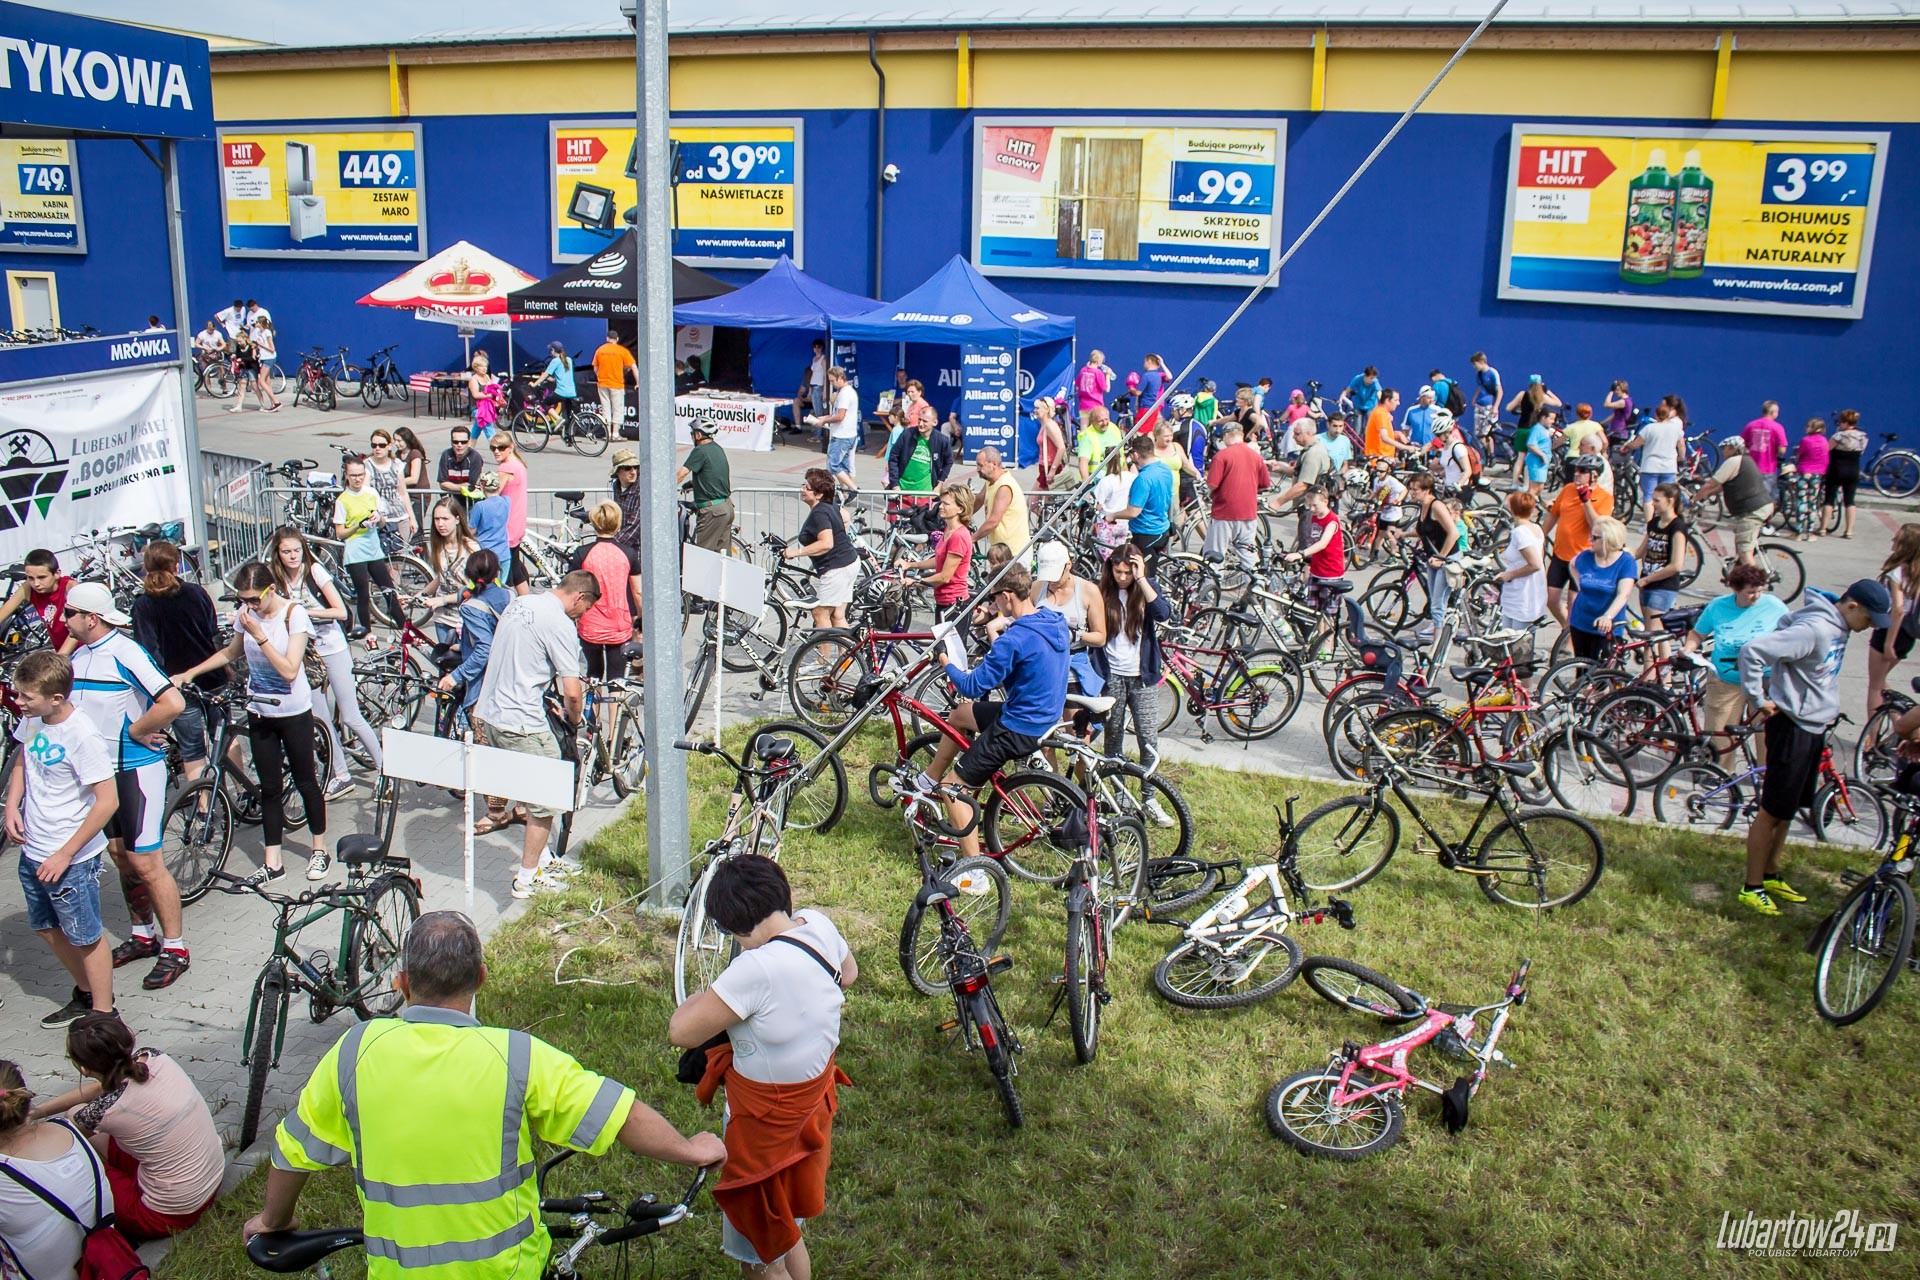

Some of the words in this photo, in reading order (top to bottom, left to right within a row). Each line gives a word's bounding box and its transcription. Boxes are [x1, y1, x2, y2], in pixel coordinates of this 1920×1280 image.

[231, 144, 253, 159] HIT
[566, 139, 593, 156] HIT
[1007, 138, 1036, 158] HIT!
[1188, 139, 1226, 151] Budujące
[1228, 142, 1265, 152] pomysły
[566, 155, 593, 163] CENOWY
[996, 153, 1041, 174] cenowy
[1538, 149, 1588, 174] HIT
[686, 166, 703, 180] od
[1535, 174, 1585, 185] CENOWY
[372, 193, 410, 203] ZESTAW
[700, 187, 784, 201] NAŚWIETLACZE
[1178, 191, 1195, 204] od
[42, 200, 69, 209] KABINA
[765, 205, 784, 216] LED
[8, 211, 13, 219] Z
[14, 209, 70, 220] HYDROMASAŻEM
[381, 207, 410, 217] MARO
[1761, 211, 1851, 226] BIOHUMUS
[1203, 216, 1261, 228] SKRZYDŁO
[13, 229, 73, 240] www.mrowka.com.pl
[340, 233, 413, 244] www.mrowka.com.pl
[1158, 228, 1219, 240] DRZWIOWE
[1222, 231, 1259, 241] HELIOS
[1780, 228, 1849, 245] NAWÓZ
[696, 237, 786, 249] www.mrowka.com.pl
[1150, 253, 1260, 269] www.mrowka.com.pl
[1745, 248, 1847, 264] NATURALNY
[563, 279, 622, 290] interduo
[1712, 278, 1843, 295] www.mrowka.com.pl
[524, 300, 558, 311] internet
[565, 301, 604, 314] telewizja
[611, 303, 639, 313] telefo
[891, 312, 950, 323] Allianz
[110, 337, 171, 361] MRÓWKA
[964, 354, 998, 365] Allianz
[965, 390, 999, 400] Allianz
[674, 404, 756, 423] Lubartowski
[719, 425, 750, 434] czytać!
[966, 426, 1000, 436] Allianz
[72, 431, 128, 457] LUBELSKI
